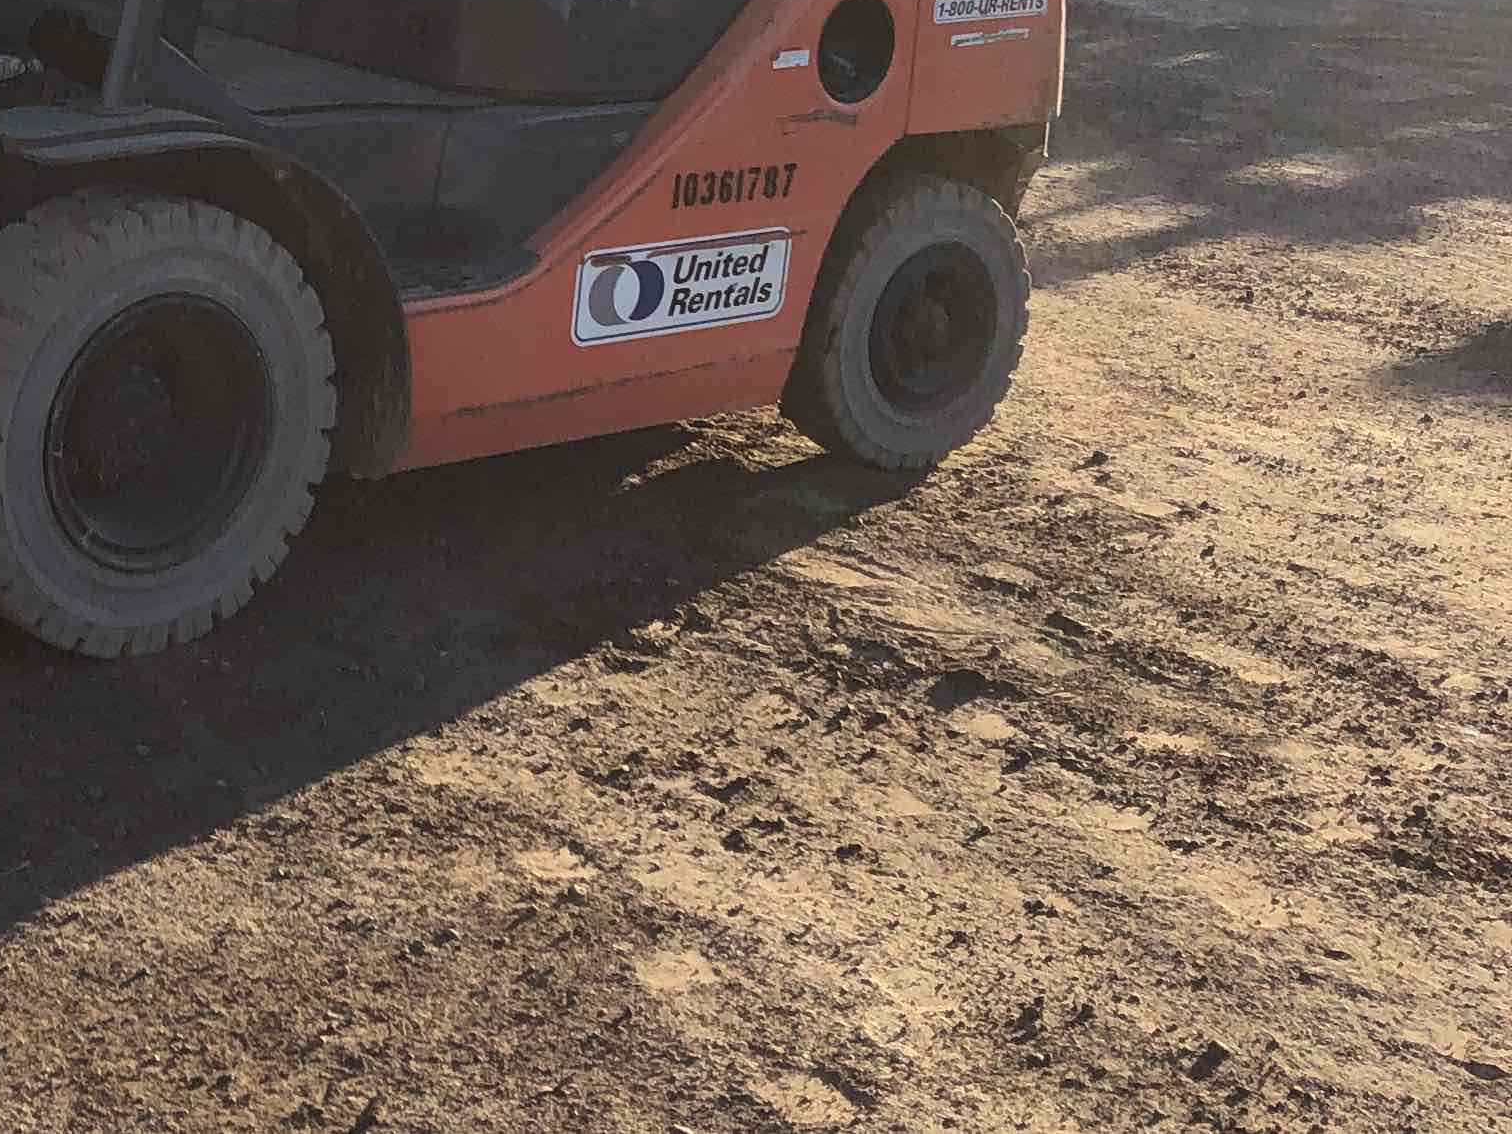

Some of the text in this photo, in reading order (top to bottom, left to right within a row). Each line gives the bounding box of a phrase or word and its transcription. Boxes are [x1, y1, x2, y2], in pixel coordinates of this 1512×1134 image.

[671, 163, 798, 209] 10361787
[673, 244, 770, 285] United
[668, 277, 773, 317] Rentals
